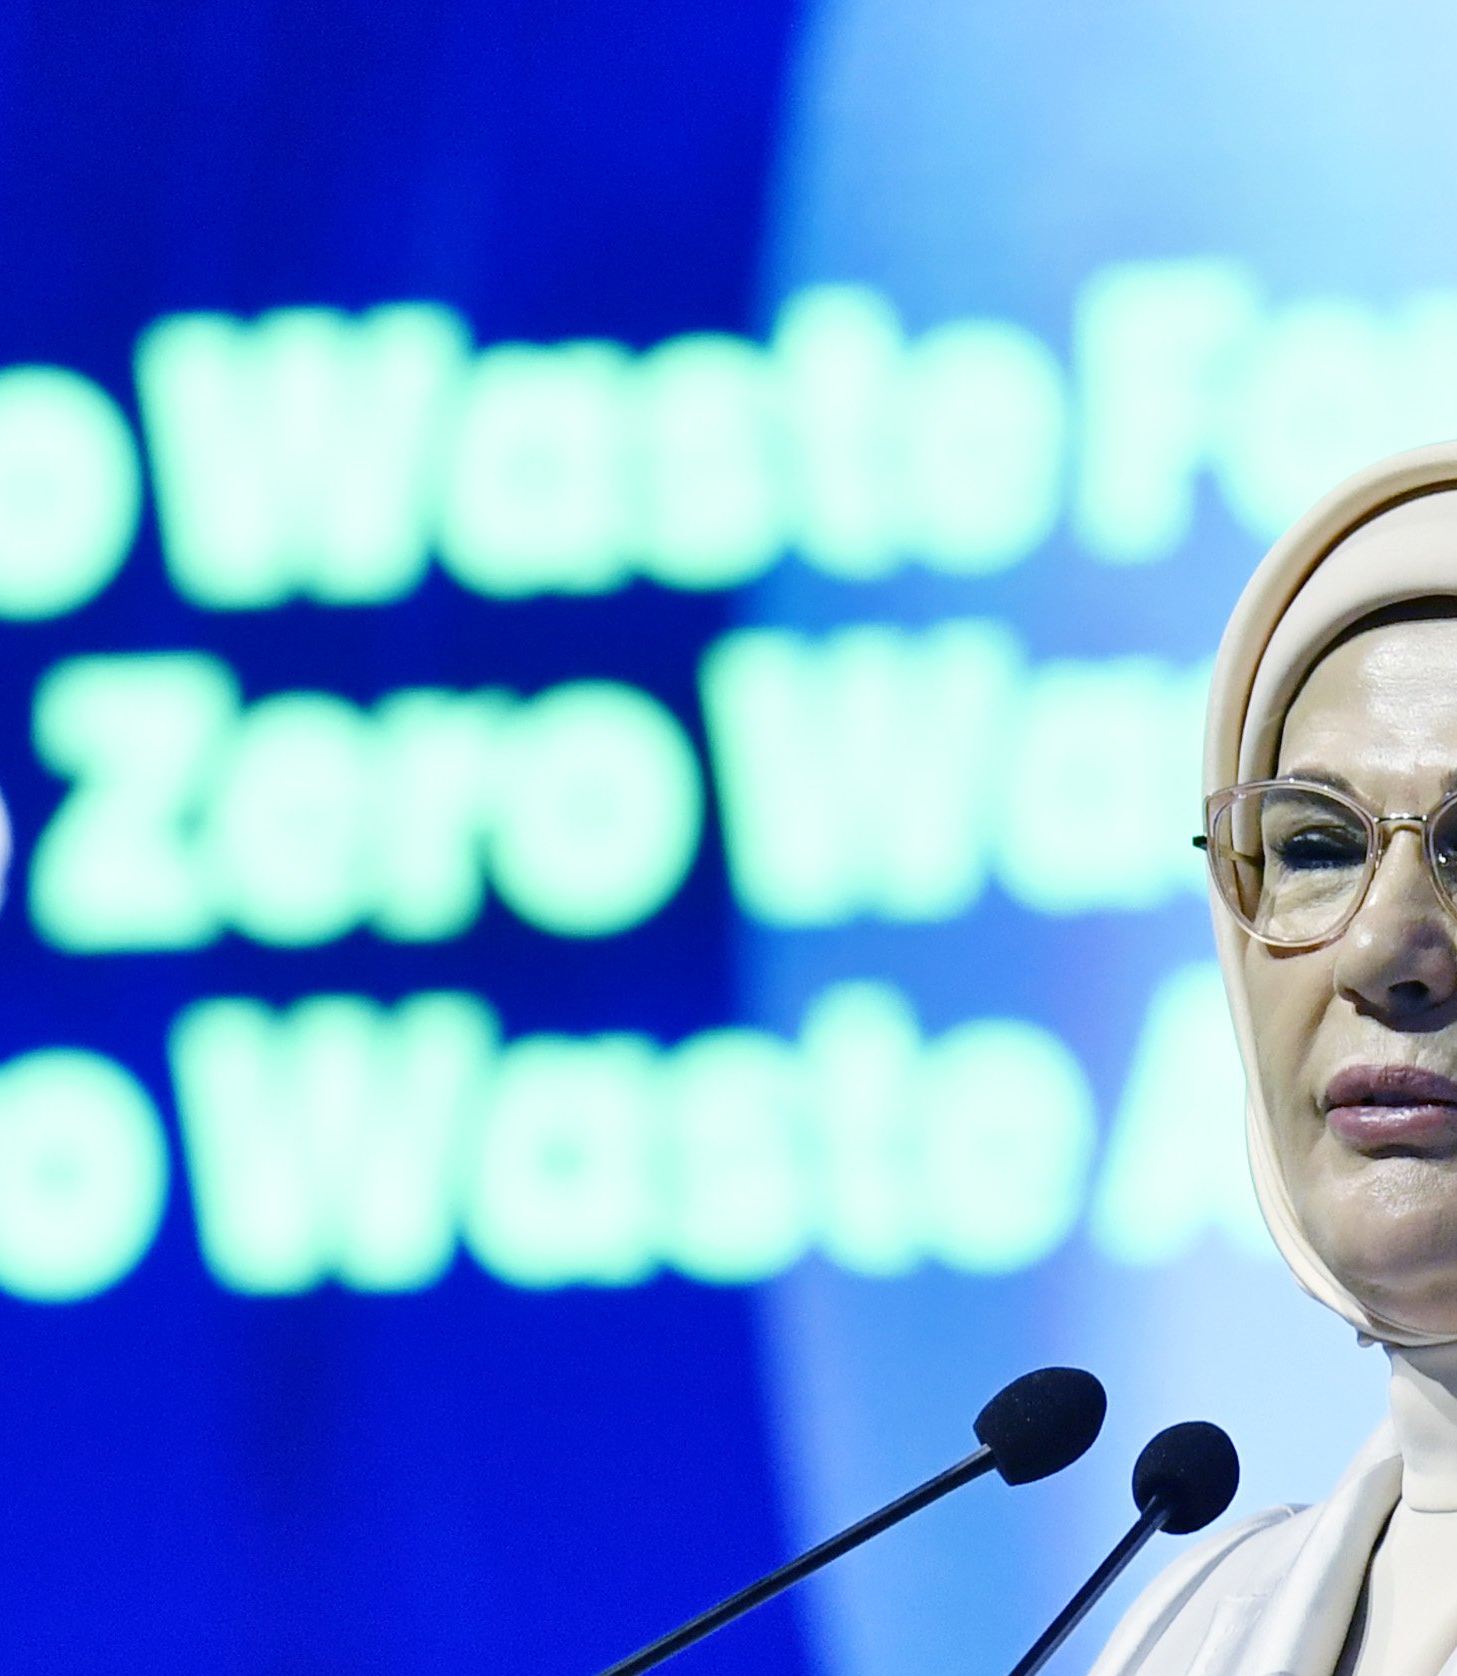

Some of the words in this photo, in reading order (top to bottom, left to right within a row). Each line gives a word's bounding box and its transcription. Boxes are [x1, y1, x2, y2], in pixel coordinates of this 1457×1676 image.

[134, 284, 1067, 610] Waste
[28, 650, 705, 955] Zero
[169, 978, 1098, 1297] Waste
